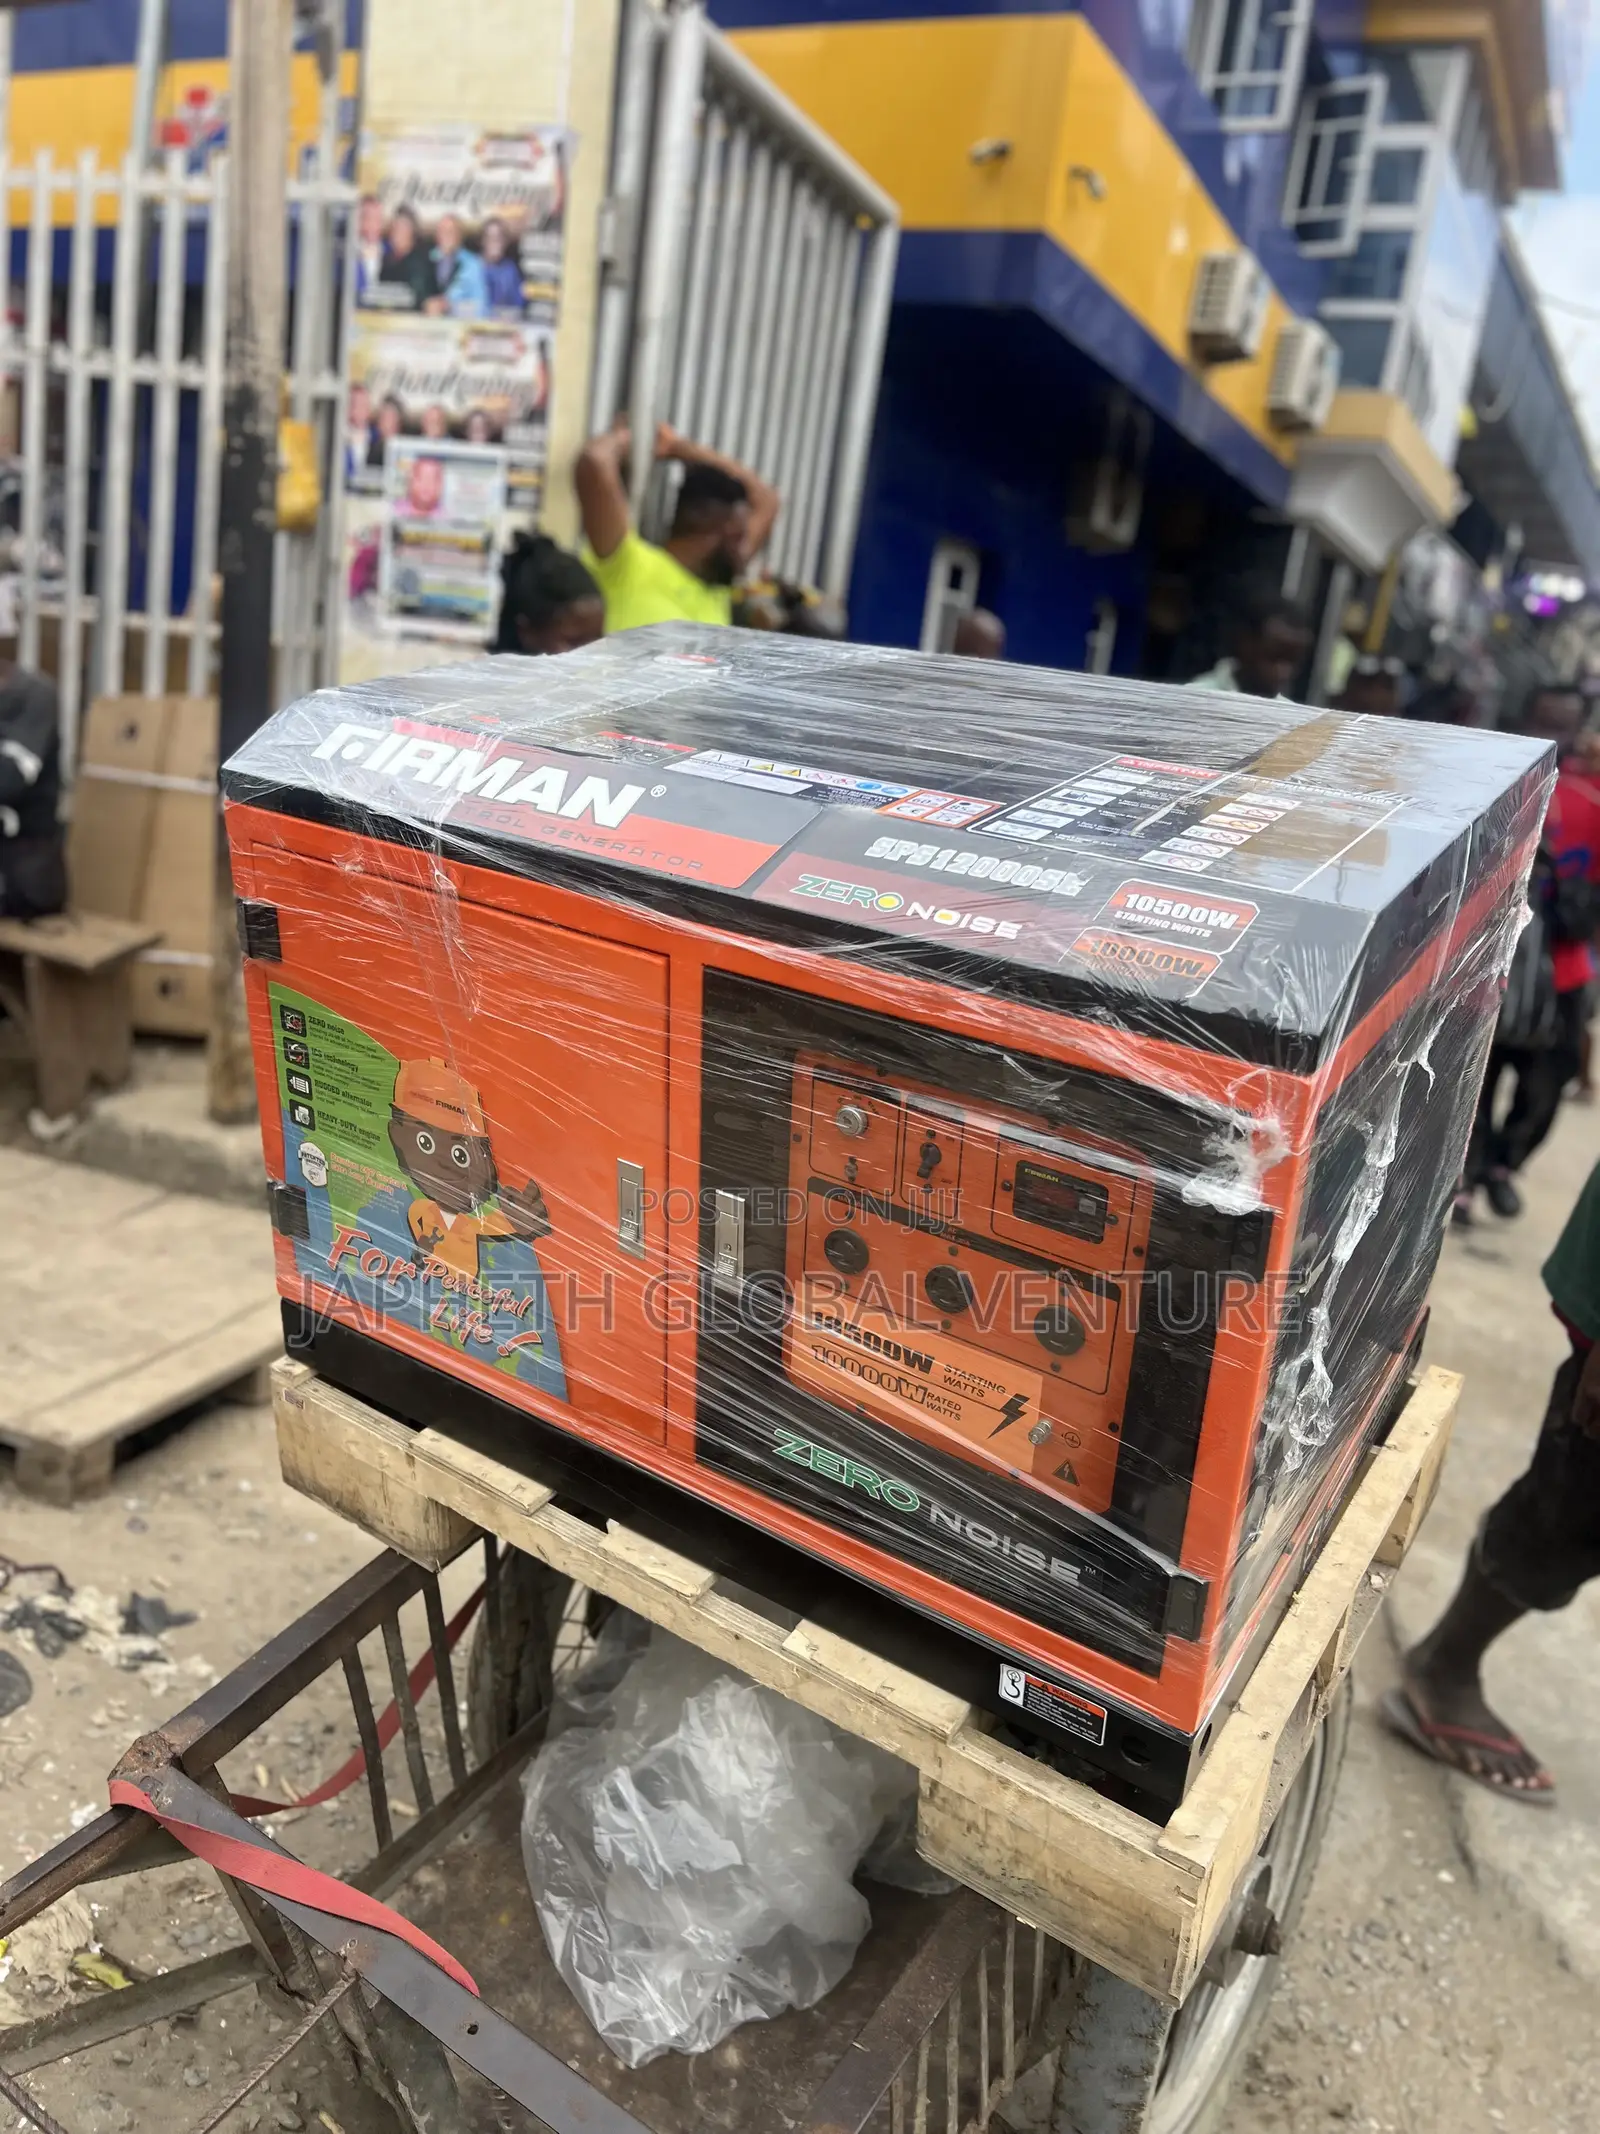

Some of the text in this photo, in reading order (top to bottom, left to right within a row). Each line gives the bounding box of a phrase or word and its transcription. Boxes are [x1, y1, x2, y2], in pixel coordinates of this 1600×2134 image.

[311, 722, 646, 829] FIRMAN
[540, 826, 704, 870] GENERATOR
[789, 873, 1023, 940] ZERO NOISE
[1113, 910, 1213, 938] STARTING WATTS
[1124, 893, 1240, 930] 10500W
[1088, 938, 1205, 979] 10000W
[308, 1015, 326, 1029] ZERO
[314, 1079, 341, 1096] RUGGED
[341, 1089, 373, 1108] alternator
[326, 1223, 416, 1286] For
[421, 1256, 534, 1321] Peaceful
[811, 1344, 962, 1412] 10000W RATED
[943, 1364, 1008, 1395] STARTING
[943, 1375, 986, 1398] WATTS
[926, 1401, 962, 1421] WATTS
[772, 1428, 920, 1513] ZERO
[929, 1502, 1081, 1587] NOISE
[1052, 1687, 1088, 1709] WARNING
